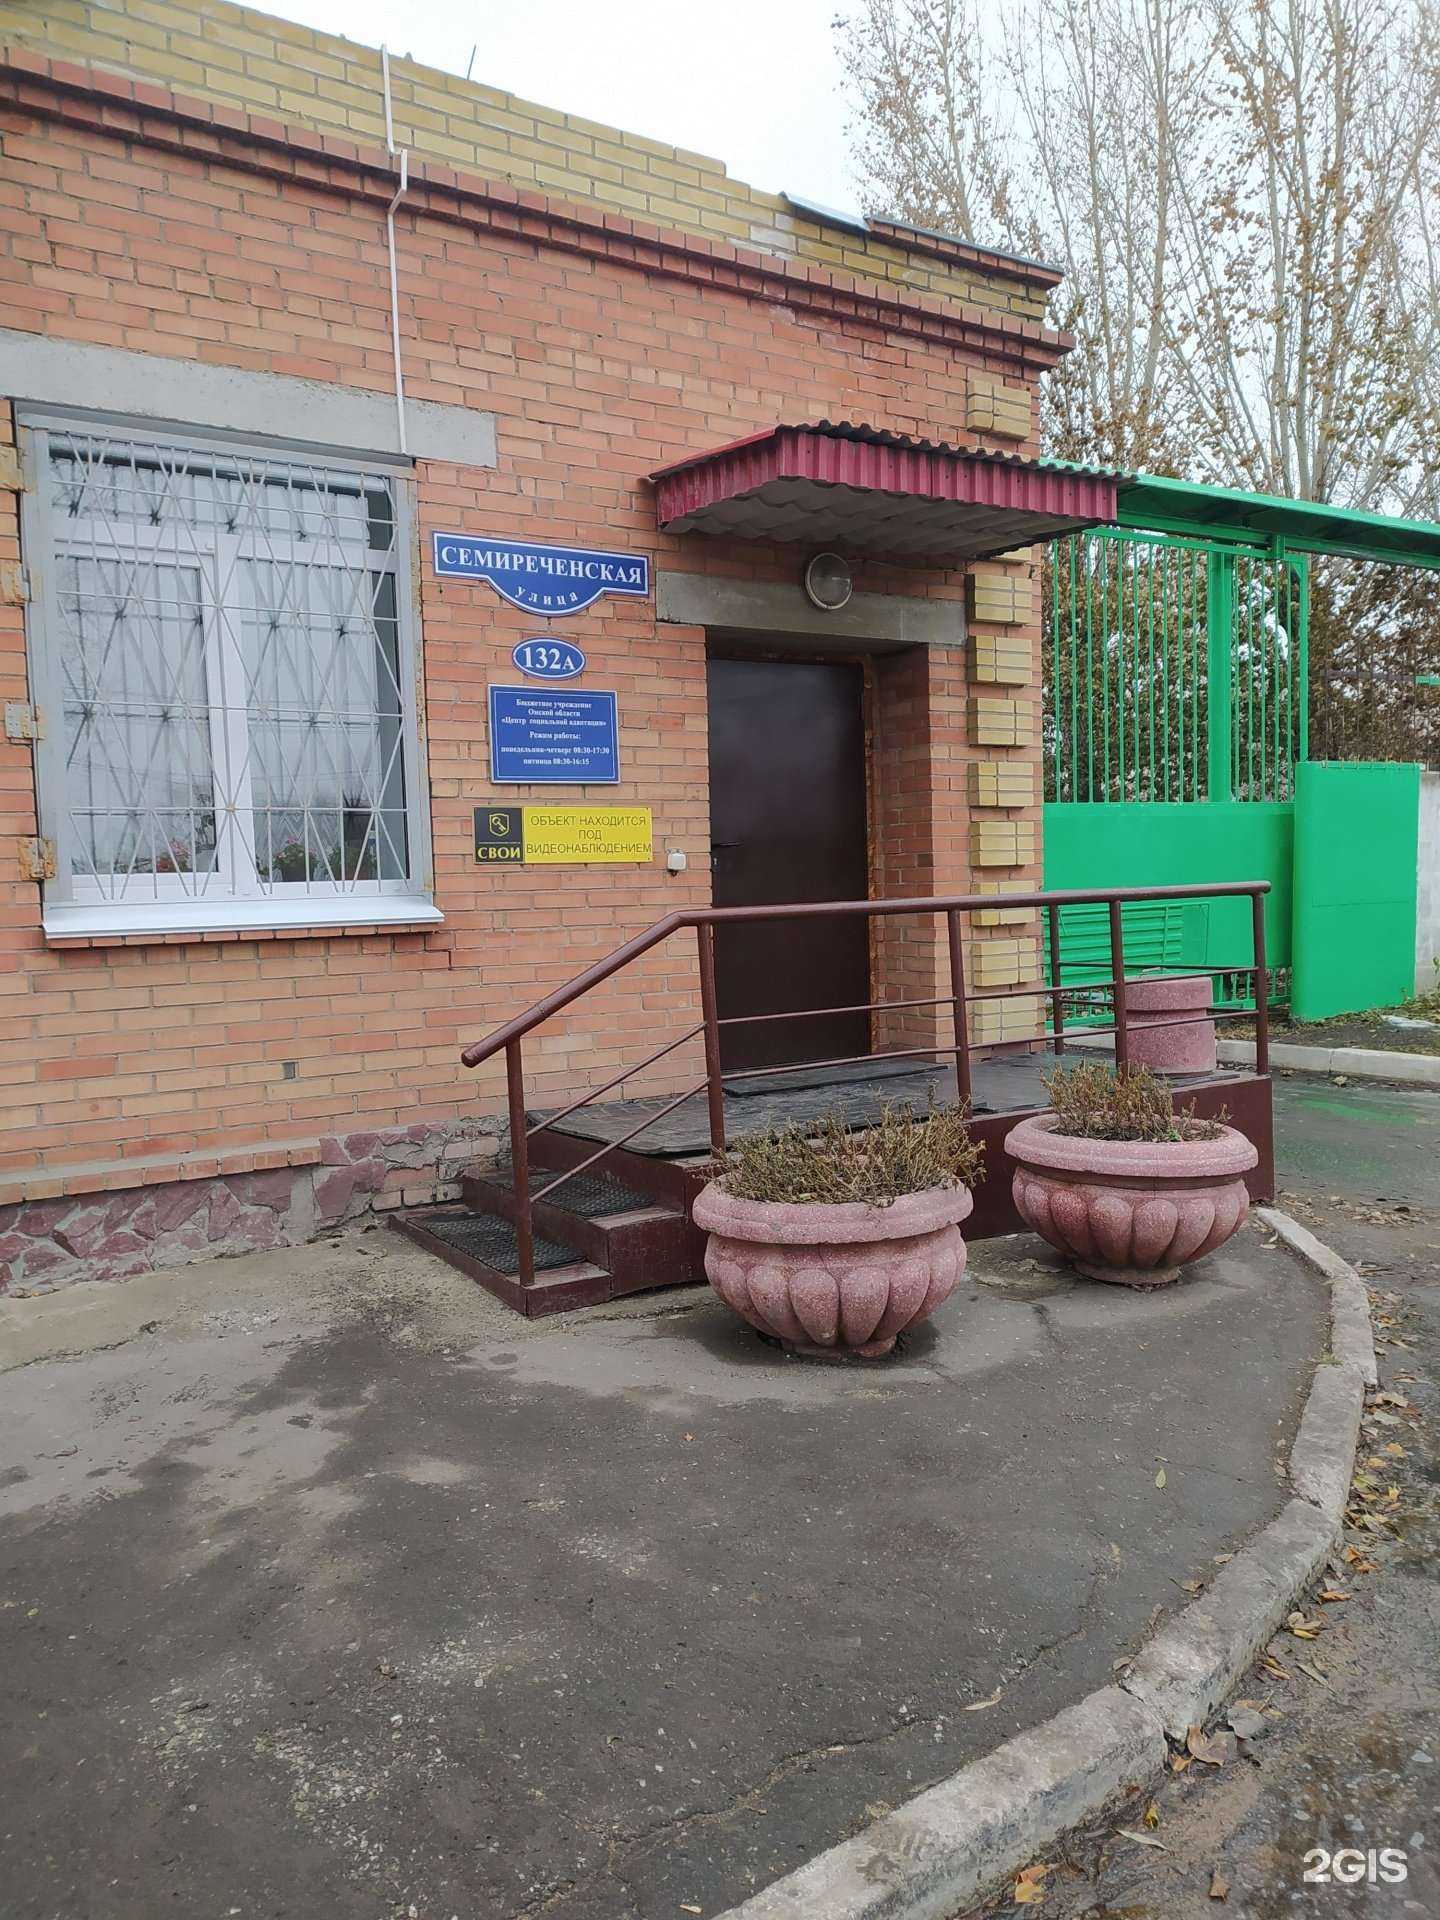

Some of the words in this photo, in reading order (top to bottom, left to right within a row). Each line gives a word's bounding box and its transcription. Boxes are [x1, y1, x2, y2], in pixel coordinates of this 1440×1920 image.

[441, 546, 642, 584] СЕМИРЕЧЕНСКАЯ
[515, 586, 578, 606] улица
[528, 708, 553, 716] Омской
[555, 709, 580, 717] области
[529, 718, 567, 726] социальной
[530, 731, 552, 739] Режим
[554, 732, 581, 740] работы:
[530, 815, 576, 826] ОБЪЕКТ
[580, 816, 646, 827] НАХОДИТСЯ
[578, 830, 602, 841] ПОД
[527, 843, 651, 854] ВИДЕОНАБЛЮДЕНИЕМ
